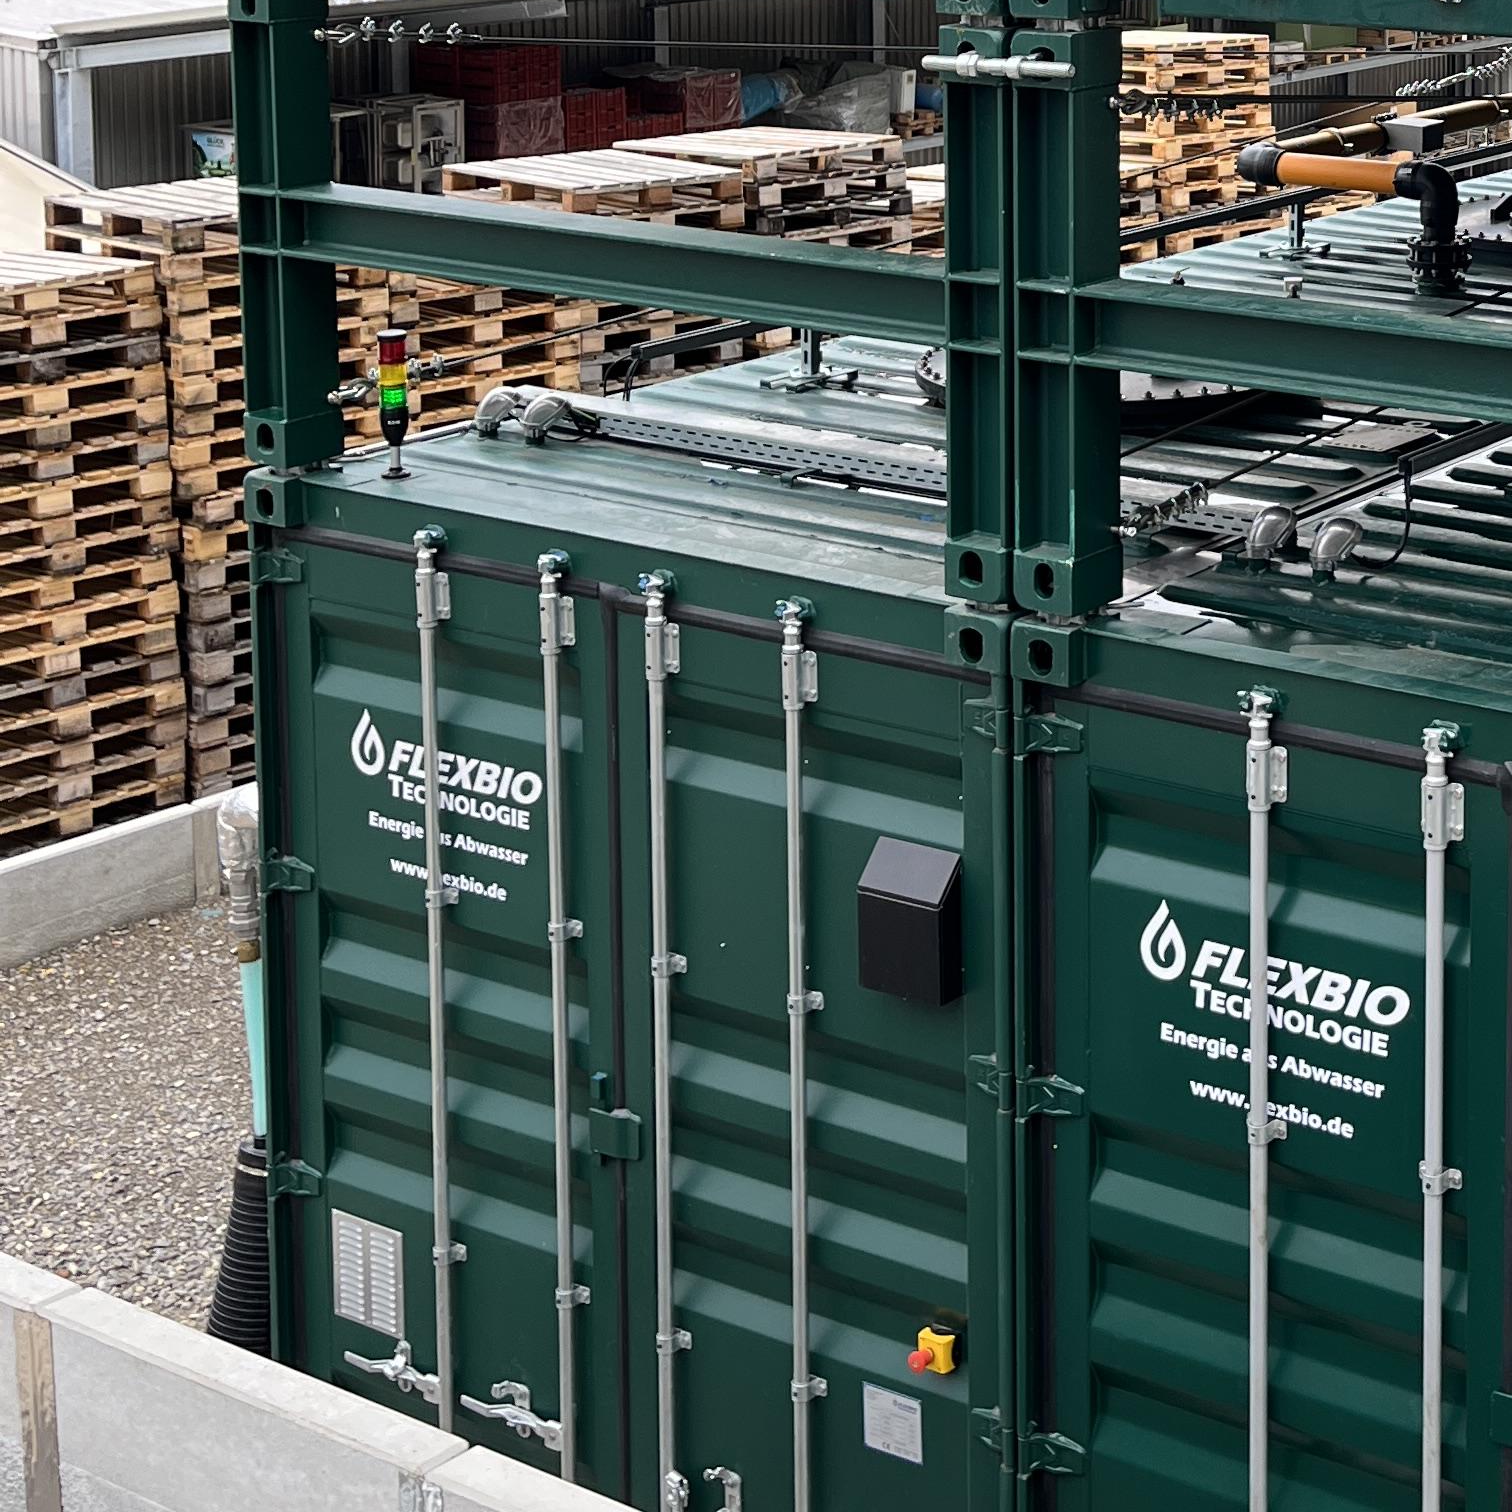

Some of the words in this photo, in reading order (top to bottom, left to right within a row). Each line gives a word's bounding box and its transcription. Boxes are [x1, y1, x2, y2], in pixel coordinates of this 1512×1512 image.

[388, 740, 542, 805] FLEXBIO
[388, 774, 530, 830] TECNOLOGIE
[368, 811, 424, 840] Energie
[453, 834, 528, 866] Abwasser
[390, 858, 507, 901] wwwexbio.de
[1191, 940, 1410, 1026] FLEXBIO
[1160, 1022, 1238, 1060] Energie
[1242, 1048, 1278, 1069] as
[1281, 1056, 1385, 1098] Abwasser
[1190, 1080, 1354, 1138] www.exbio.de
